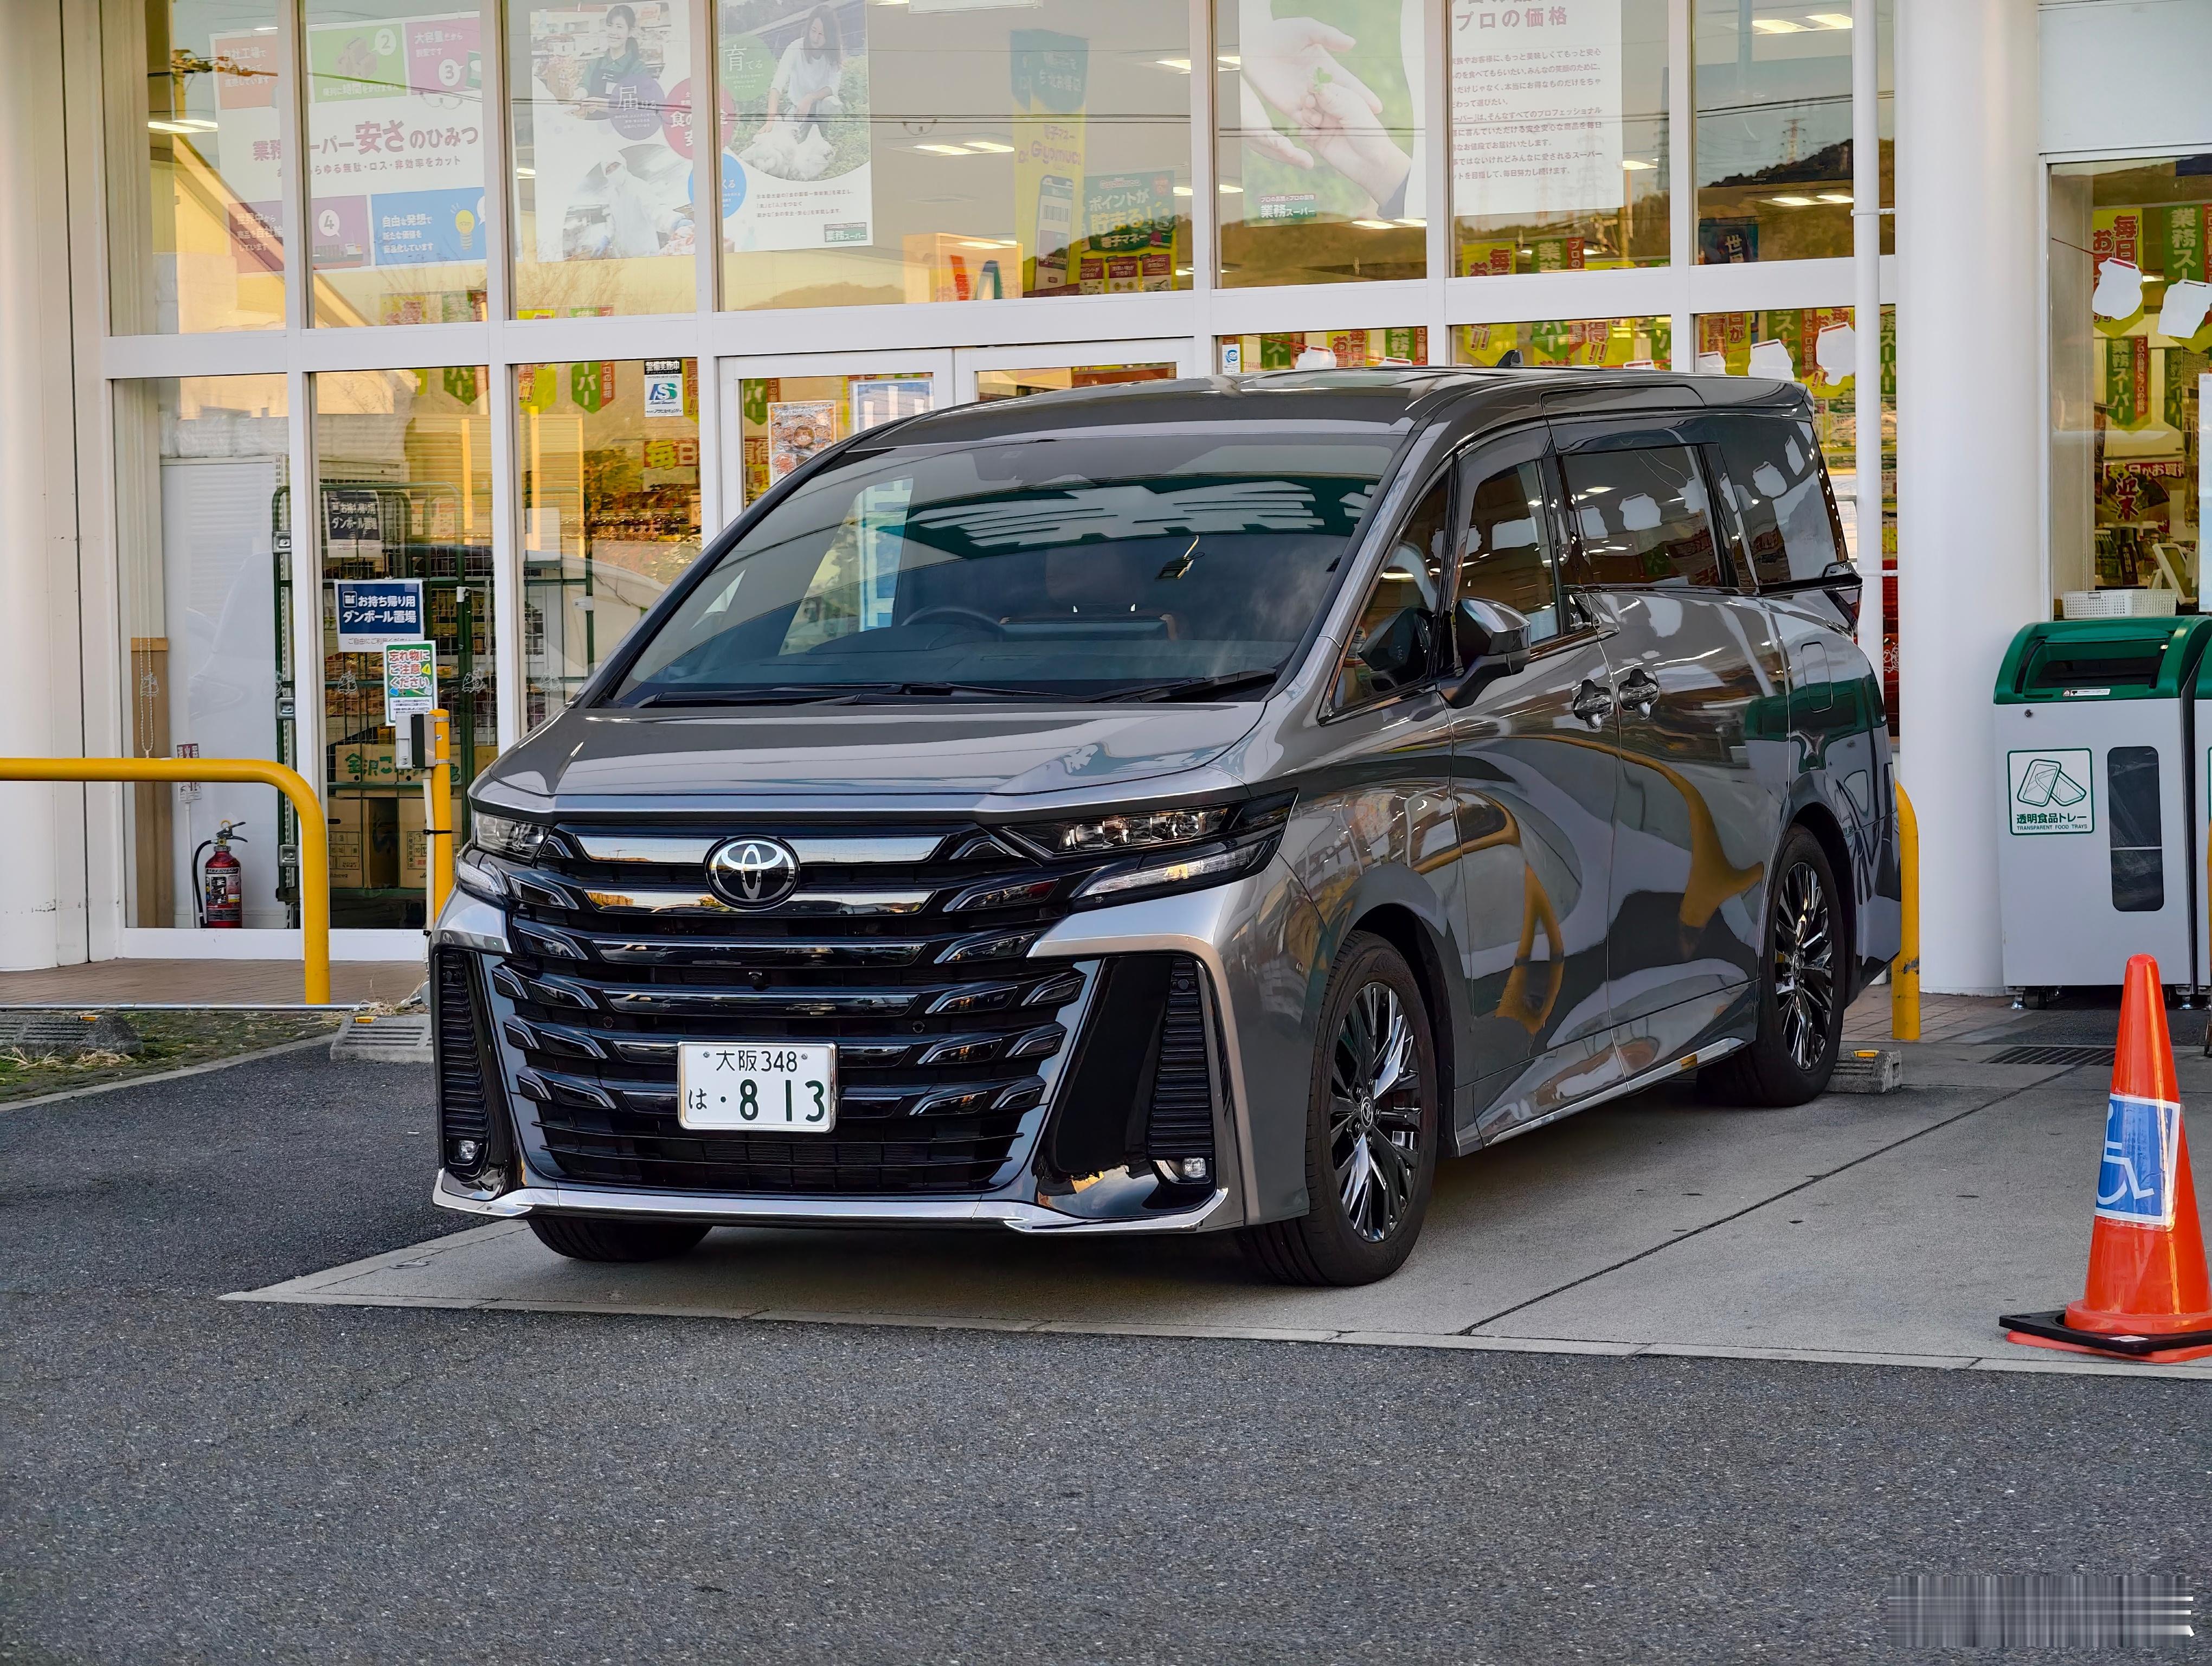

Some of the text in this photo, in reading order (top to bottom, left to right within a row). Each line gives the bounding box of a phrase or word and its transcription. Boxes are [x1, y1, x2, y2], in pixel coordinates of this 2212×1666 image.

[1456, 6, 1567, 31] プロの価格
[381, 35, 390, 49] 2
[445, 64, 455, 80] 3
[1089, 188, 1150, 212] ポイントが
[1261, 204, 1316, 218] 業務スーパー
[324, 214, 334, 230] 4
[825, 230, 867, 242] 業務スーパー
[646, 360, 680, 371] 警備実施中
[2112, 339, 2130, 426] 業務スーパー
[646, 440, 698, 470] 毎日
[358, 595, 416, 607] お持ち帰り用
[343, 610, 417, 624] ダンボール置場
[388, 649, 430, 663] 忘れ物に
[389, 663, 422, 676] ご注意
[390, 676, 430, 689] ください
[2016, 812, 2087, 824] 透明食品トレー
[689, 1088, 707, 1110] は
